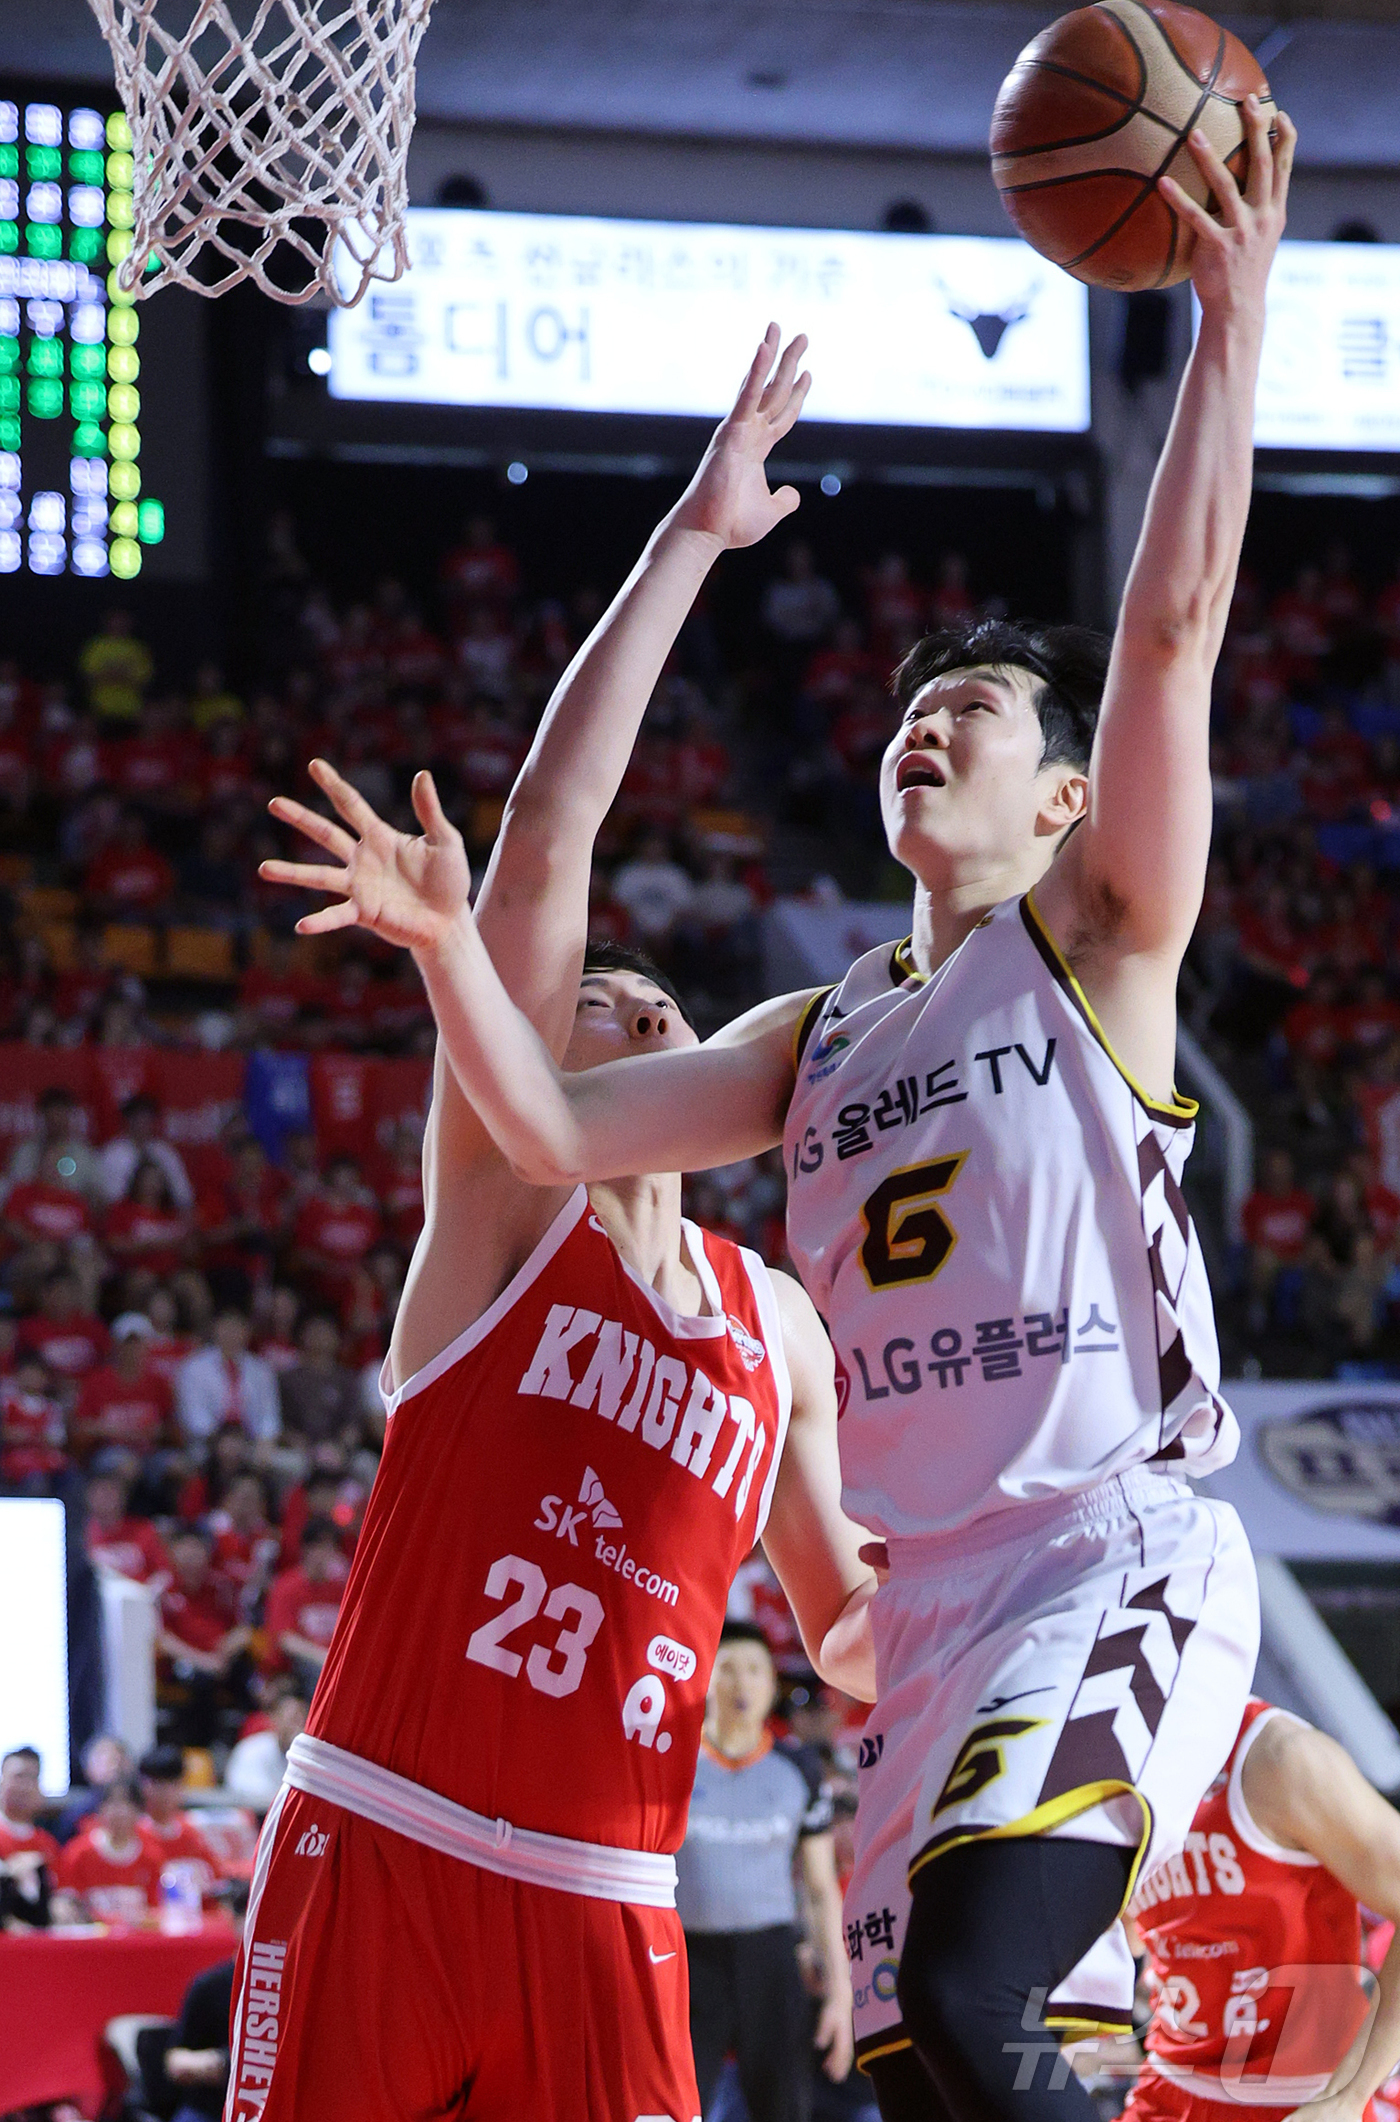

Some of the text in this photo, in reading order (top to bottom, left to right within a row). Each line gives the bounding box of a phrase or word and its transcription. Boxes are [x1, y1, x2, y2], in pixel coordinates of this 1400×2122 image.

[832, 1060, 969, 1161] 올레드
[975, 1038, 1057, 1094] TV
[858, 1149, 972, 1293] 6
[852, 1303, 1120, 1401] LG유플러스
[517, 1303, 766, 1523] KNIGHTS
[533, 1494, 681, 1607] SK telecom
[465, 1553, 606, 1699] 23
[655, 1643, 690, 1675] 에이닷
[931, 1714, 1053, 1825] 6
